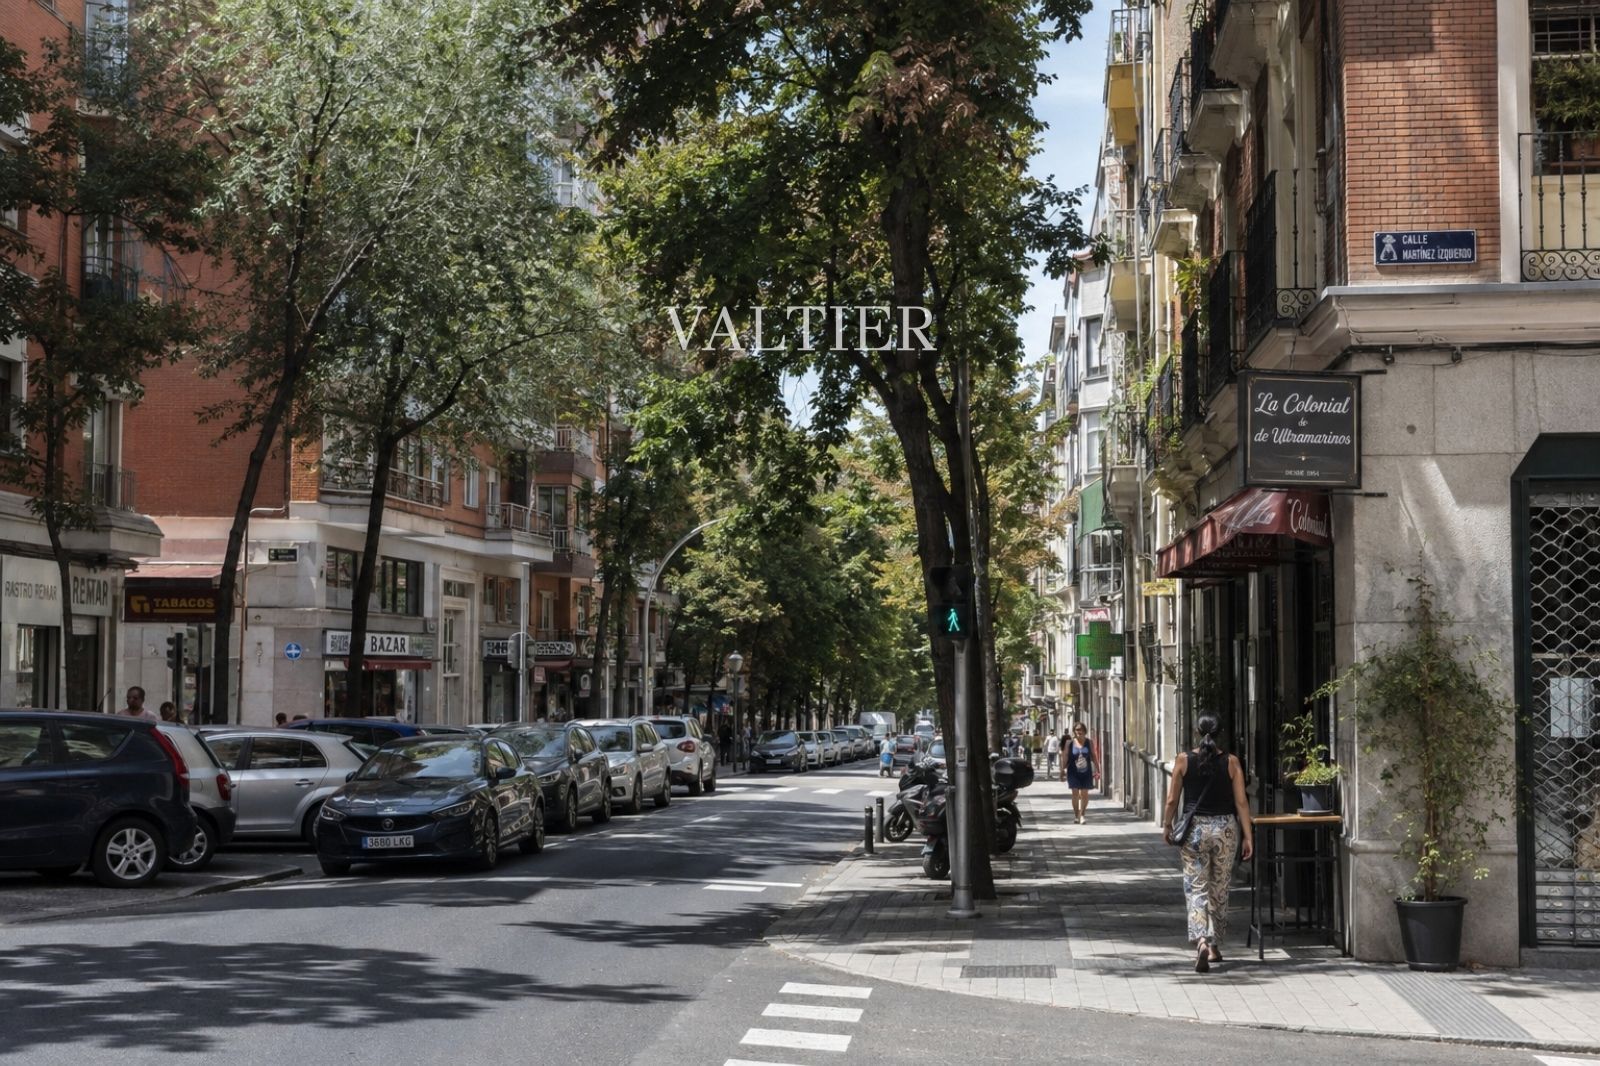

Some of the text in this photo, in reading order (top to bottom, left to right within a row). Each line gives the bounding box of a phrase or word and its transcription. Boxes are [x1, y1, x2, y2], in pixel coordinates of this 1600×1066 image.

[1402, 234, 1428, 245] CALLE
[1254, 392, 1351, 416] La Colonial
[1254, 427, 1351, 445] de Ultramarinos
[4, 581, 33, 599] RASTRO
[153, 598, 215, 608] TABACOS
[371, 635, 406, 653] BAZAR
[368, 836, 411, 848] 3680 LKG
